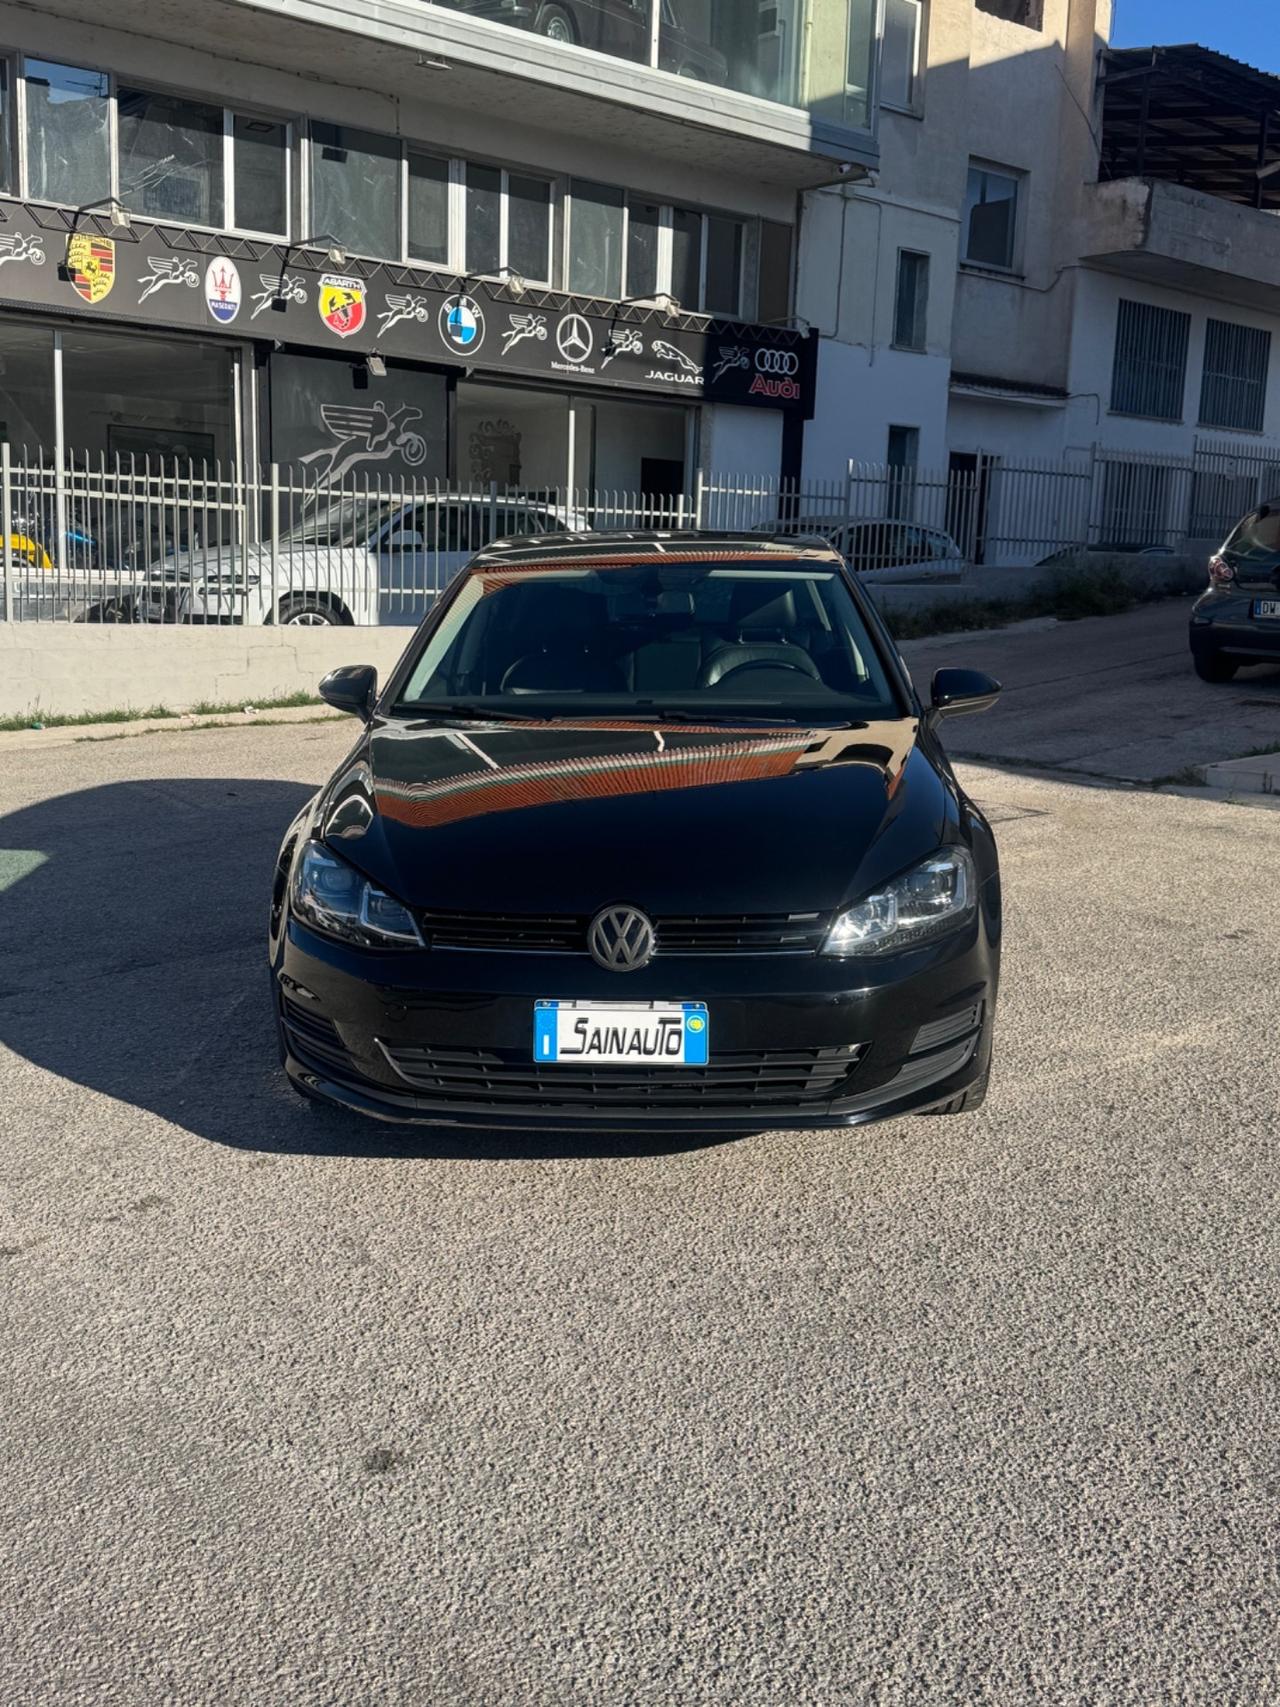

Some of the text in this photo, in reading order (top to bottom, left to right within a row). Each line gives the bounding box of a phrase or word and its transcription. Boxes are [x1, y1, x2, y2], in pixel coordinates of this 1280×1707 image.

[322, 276, 363, 290] ABARTH
[443, 297, 482, 318] BMW
[550, 361, 596, 374] Mercedes-Benz
[644, 370, 704, 385] JAGUAR
[559, 1017, 682, 1056] SAINAUTO
